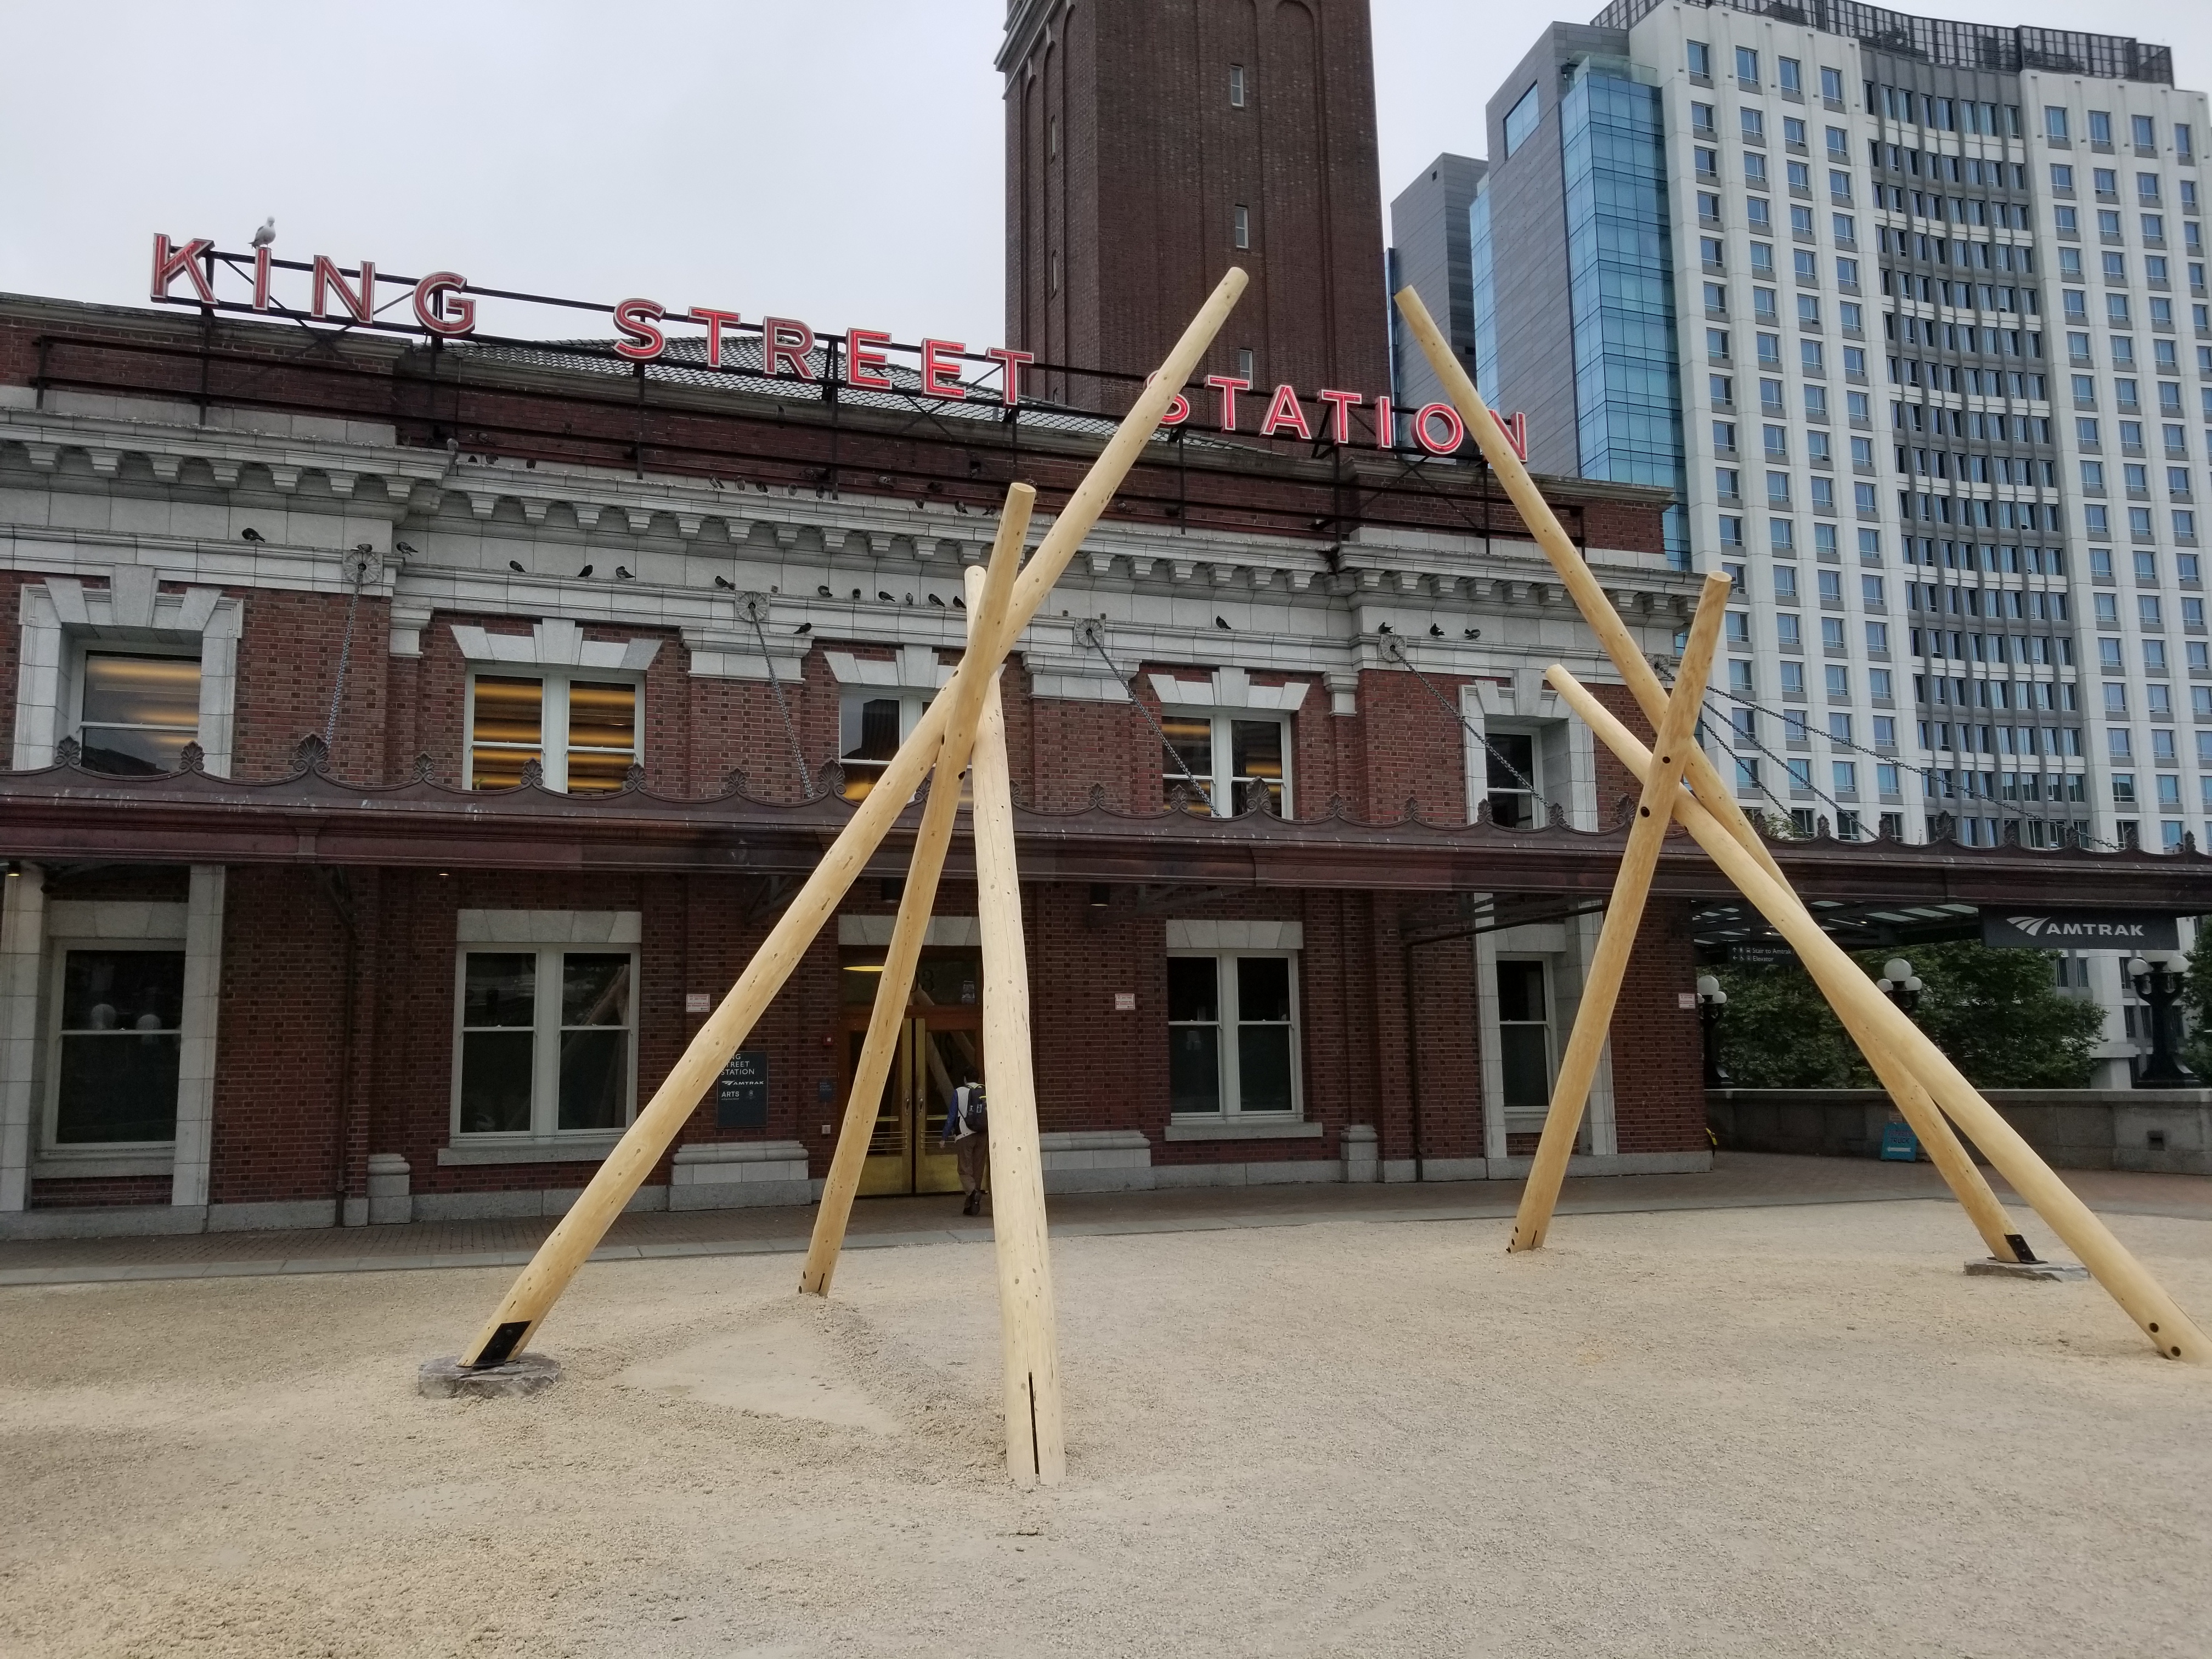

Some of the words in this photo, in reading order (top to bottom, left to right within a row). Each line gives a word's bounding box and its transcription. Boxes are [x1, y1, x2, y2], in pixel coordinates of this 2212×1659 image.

[150, 233, 476, 338] KING
[613, 297, 1035, 408] STREET
[2046, 922, 2145, 936] AMTRAK
